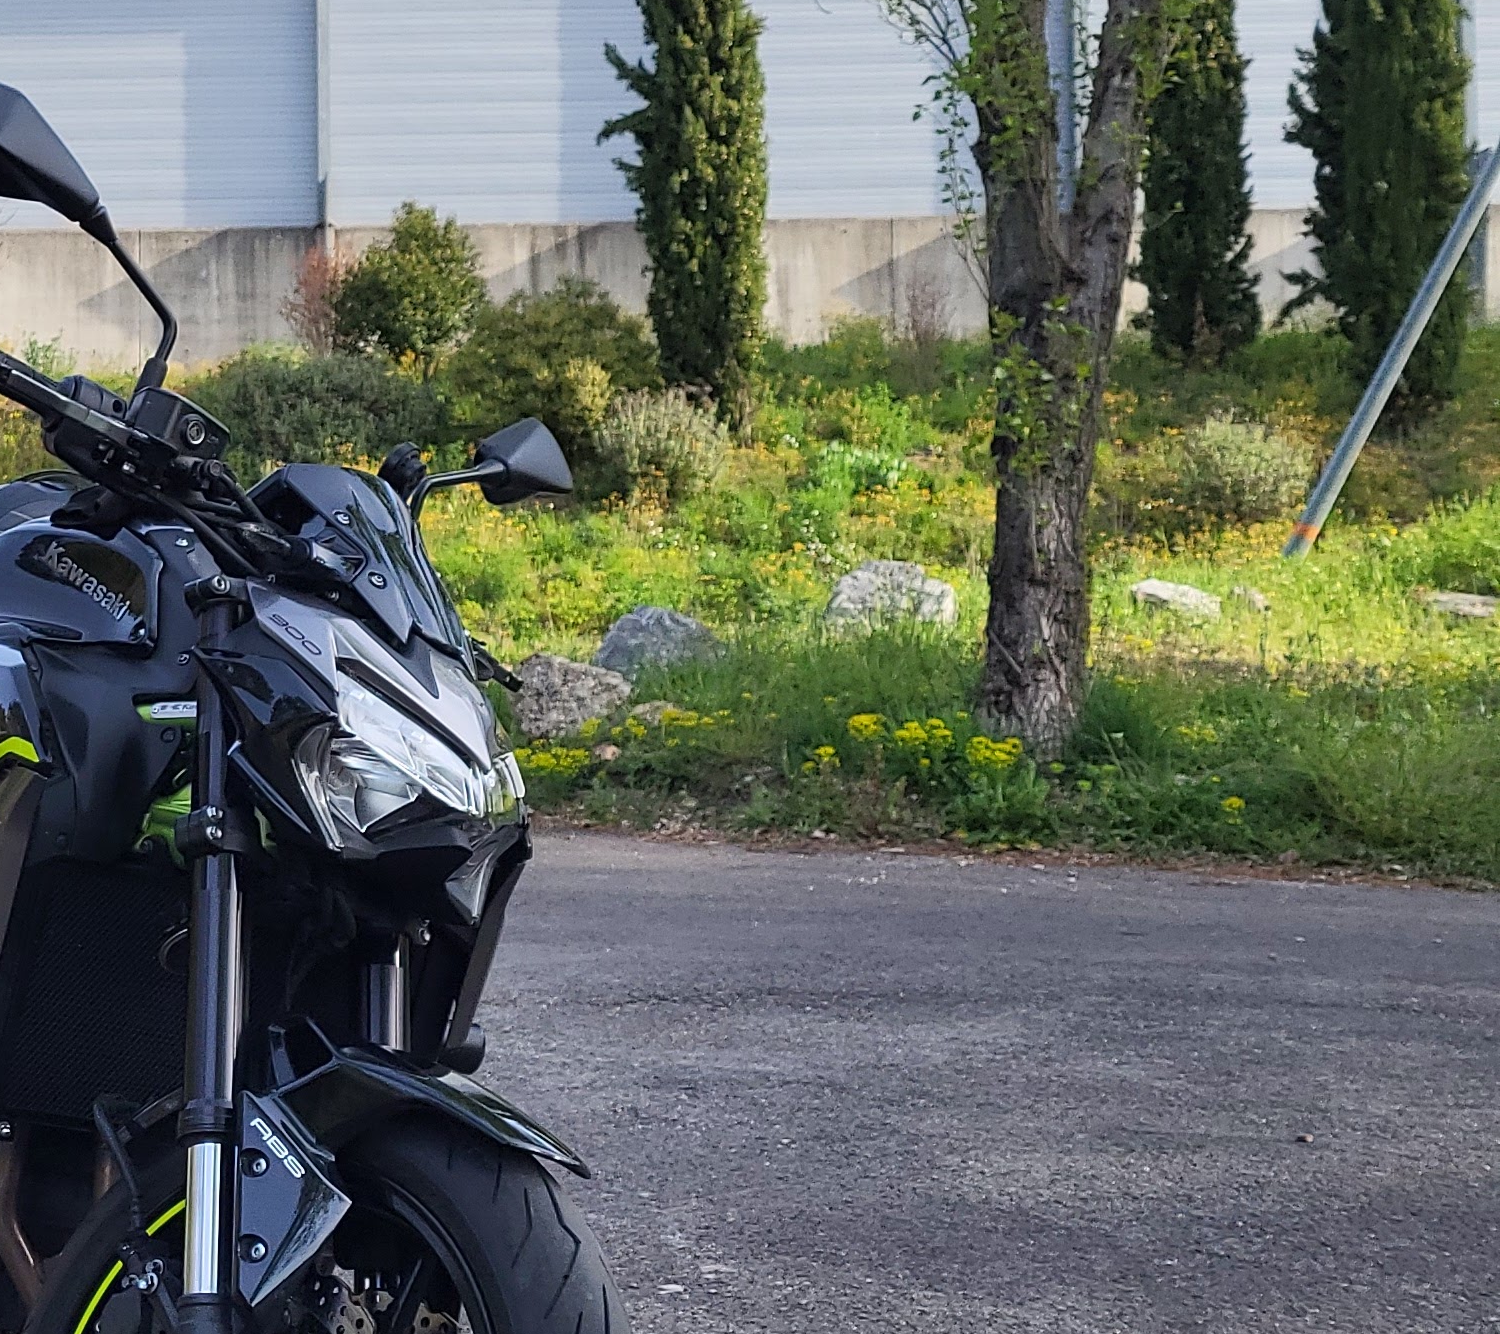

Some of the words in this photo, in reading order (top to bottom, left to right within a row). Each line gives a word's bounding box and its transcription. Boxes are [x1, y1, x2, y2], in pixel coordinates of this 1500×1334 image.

[42, 541, 131, 622] Kawasaki
[268, 614, 322, 655] 900
[249, 1117, 306, 1179] ABS
